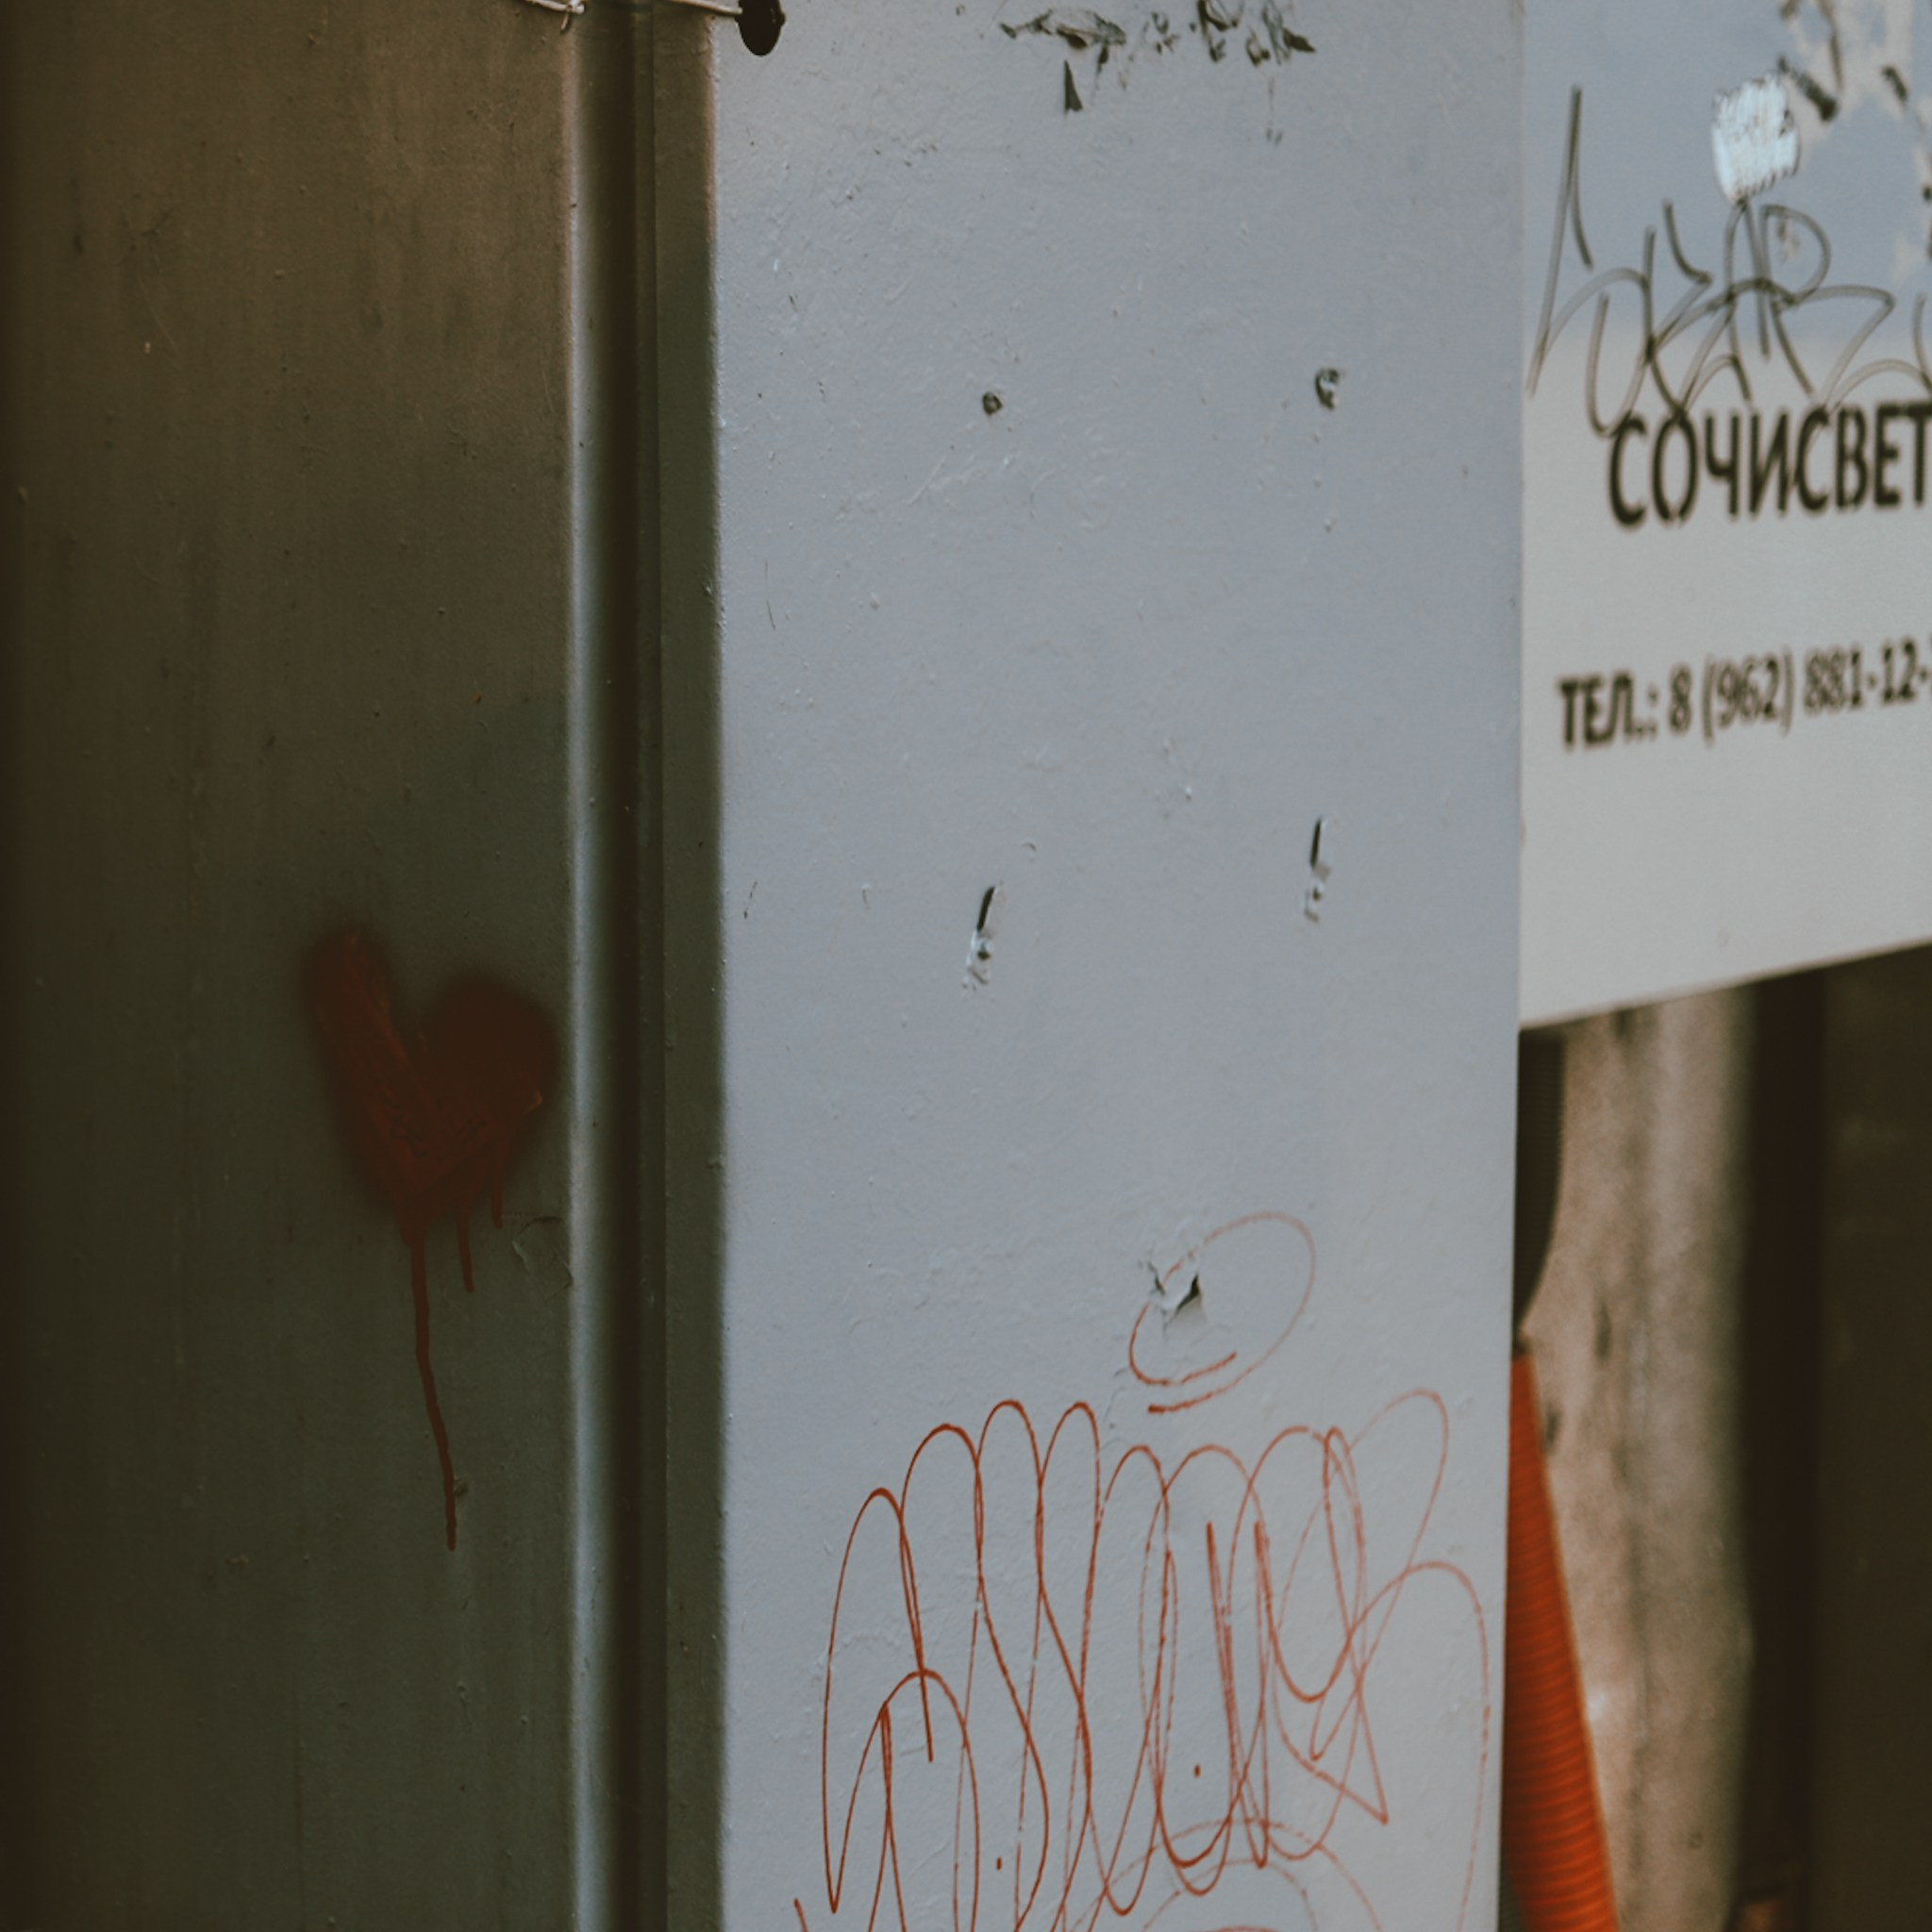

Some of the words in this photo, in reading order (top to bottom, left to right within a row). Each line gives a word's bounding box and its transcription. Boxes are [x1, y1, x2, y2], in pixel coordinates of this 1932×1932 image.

[1607, 401, 1932, 530] СОЧИСВЕТ
[1558, 670, 1658, 748] ТЕЛ.:
[1667, 662, 1694, 736] 8
[1700, 646, 1794, 747] (962)
[1803, 634, 1932, 715] 881-12-
